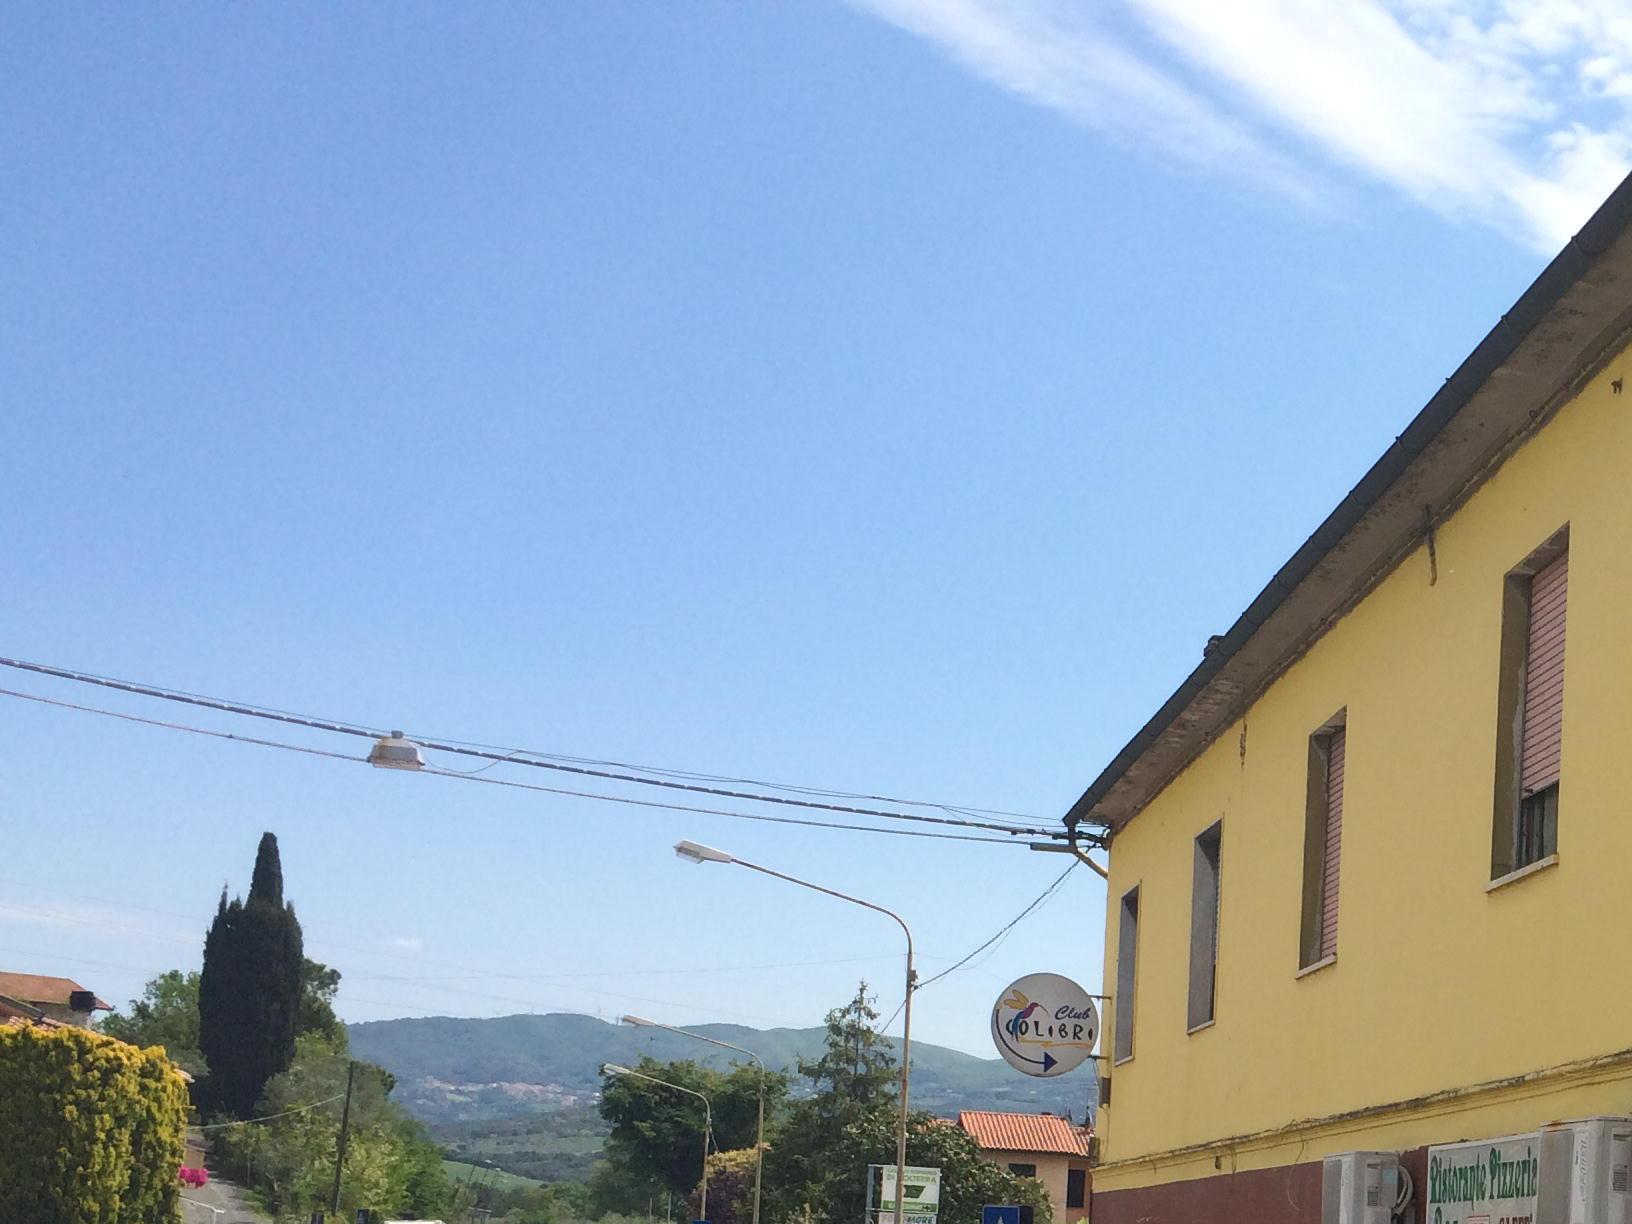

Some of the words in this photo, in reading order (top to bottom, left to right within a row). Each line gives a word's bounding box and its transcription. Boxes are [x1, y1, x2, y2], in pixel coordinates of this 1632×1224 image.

[1055, 1005, 1091, 1020] Club
[1006, 1019, 1093, 1040] COLIBRI
[1430, 1153, 1487, 1205] Ristorante
[1489, 1146, 1538, 1199] Pizzeria
